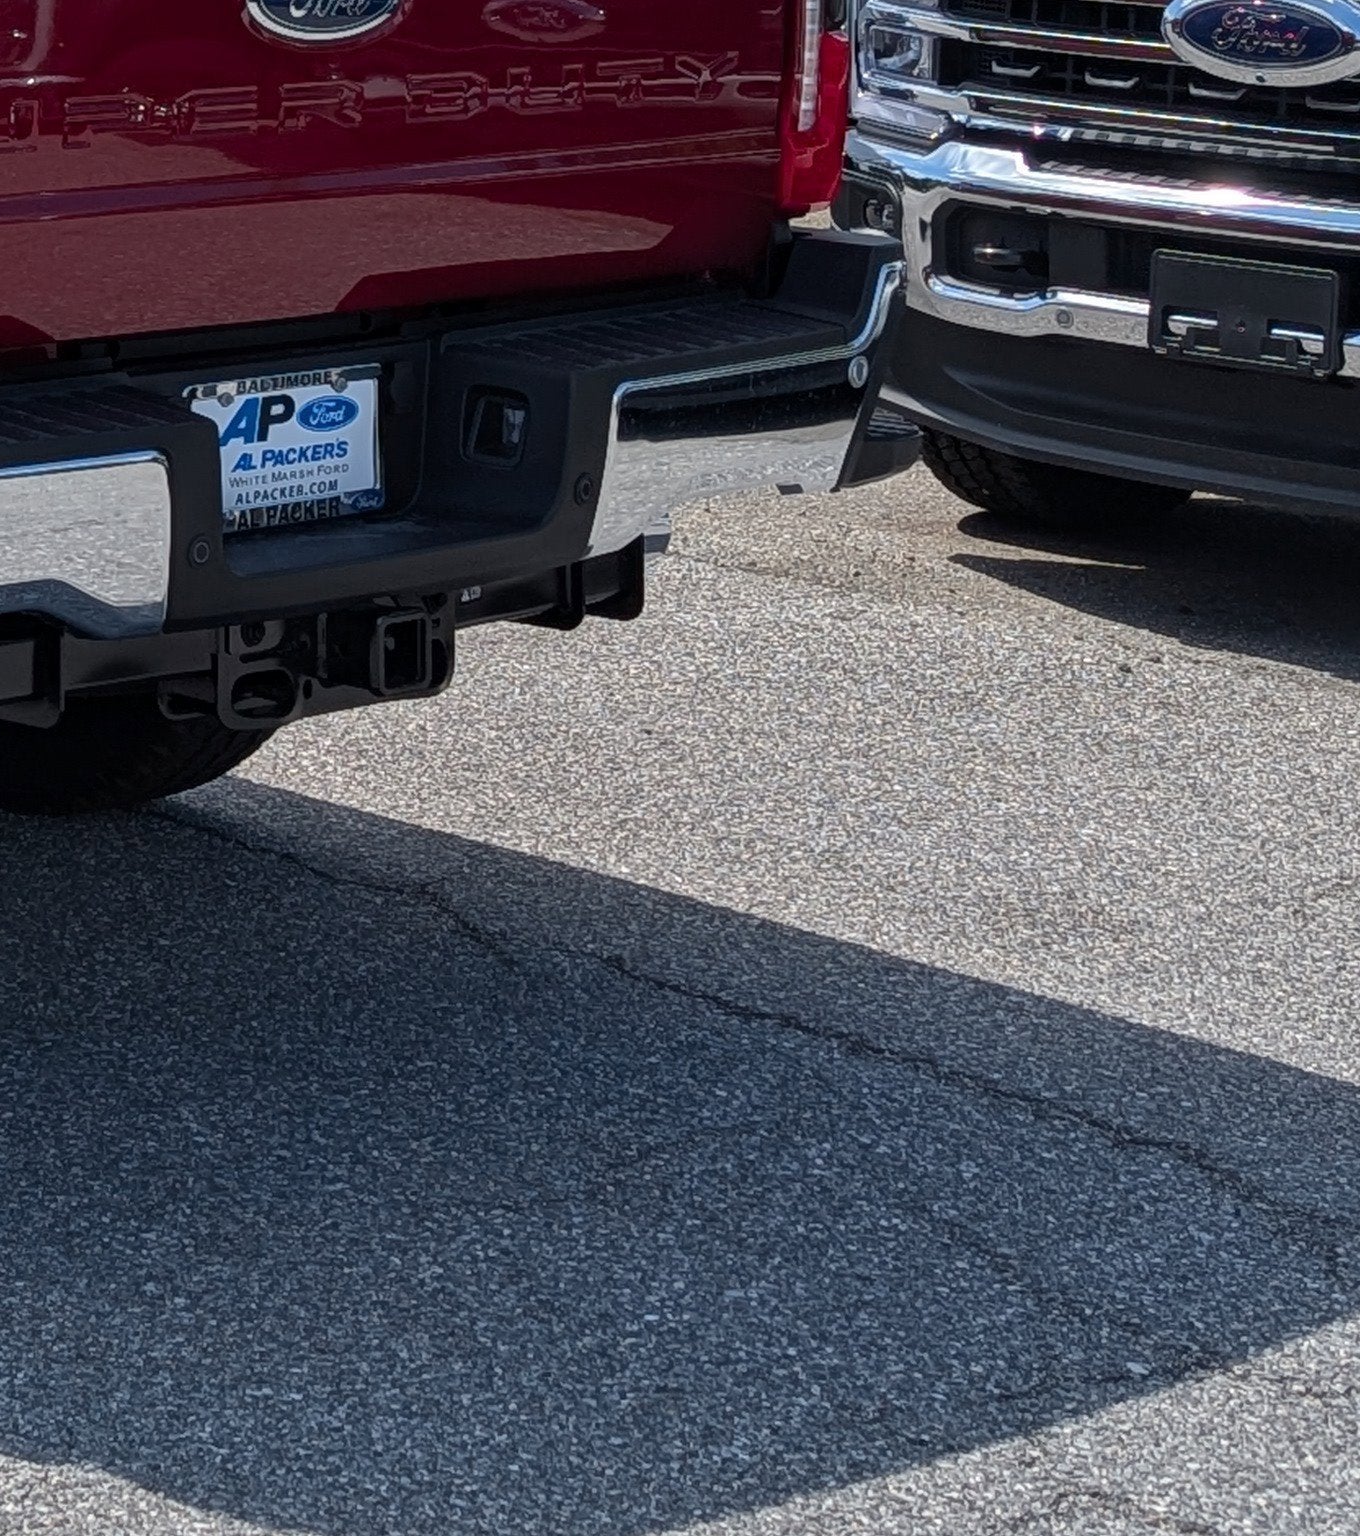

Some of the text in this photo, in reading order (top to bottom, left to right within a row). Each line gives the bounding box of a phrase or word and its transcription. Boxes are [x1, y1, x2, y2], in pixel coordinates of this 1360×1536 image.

[1211, 8, 1309, 56] Ford
[405, 50, 739, 124] DUTY
[220, 394, 296, 447] AP
[310, 402, 346, 426] Ford
[231, 438, 349, 473] AL PACKER'S
[317, 464, 350, 476] FORD
